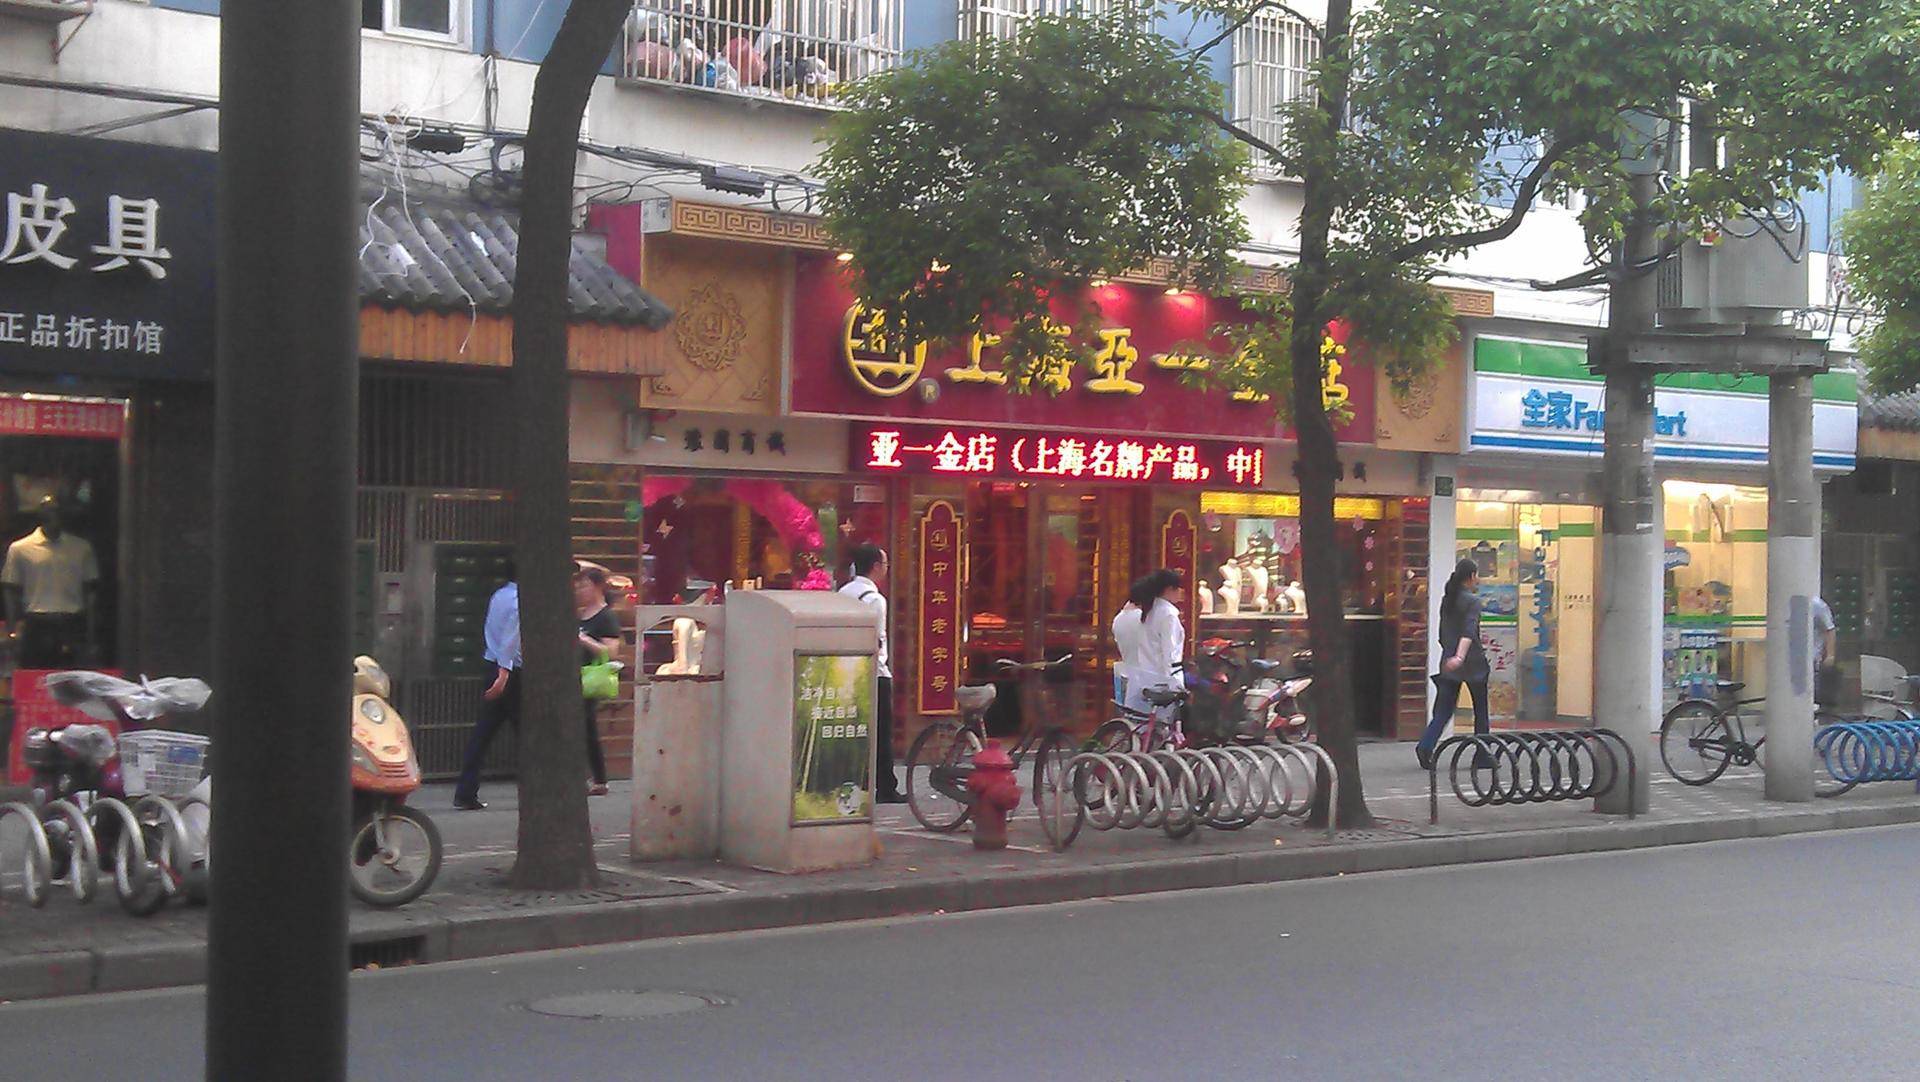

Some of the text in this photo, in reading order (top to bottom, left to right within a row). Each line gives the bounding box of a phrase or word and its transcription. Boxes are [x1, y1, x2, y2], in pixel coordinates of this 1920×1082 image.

[0, 183, 172, 279] 皮具
[0, 311, 164, 355] 正品折扣馆
[1521, 388, 1572, 430] 全家
[866, 430, 1263, 486] 亚一金店（上海名牌产品，中
[931, 560, 949, 692] 中华老字号
